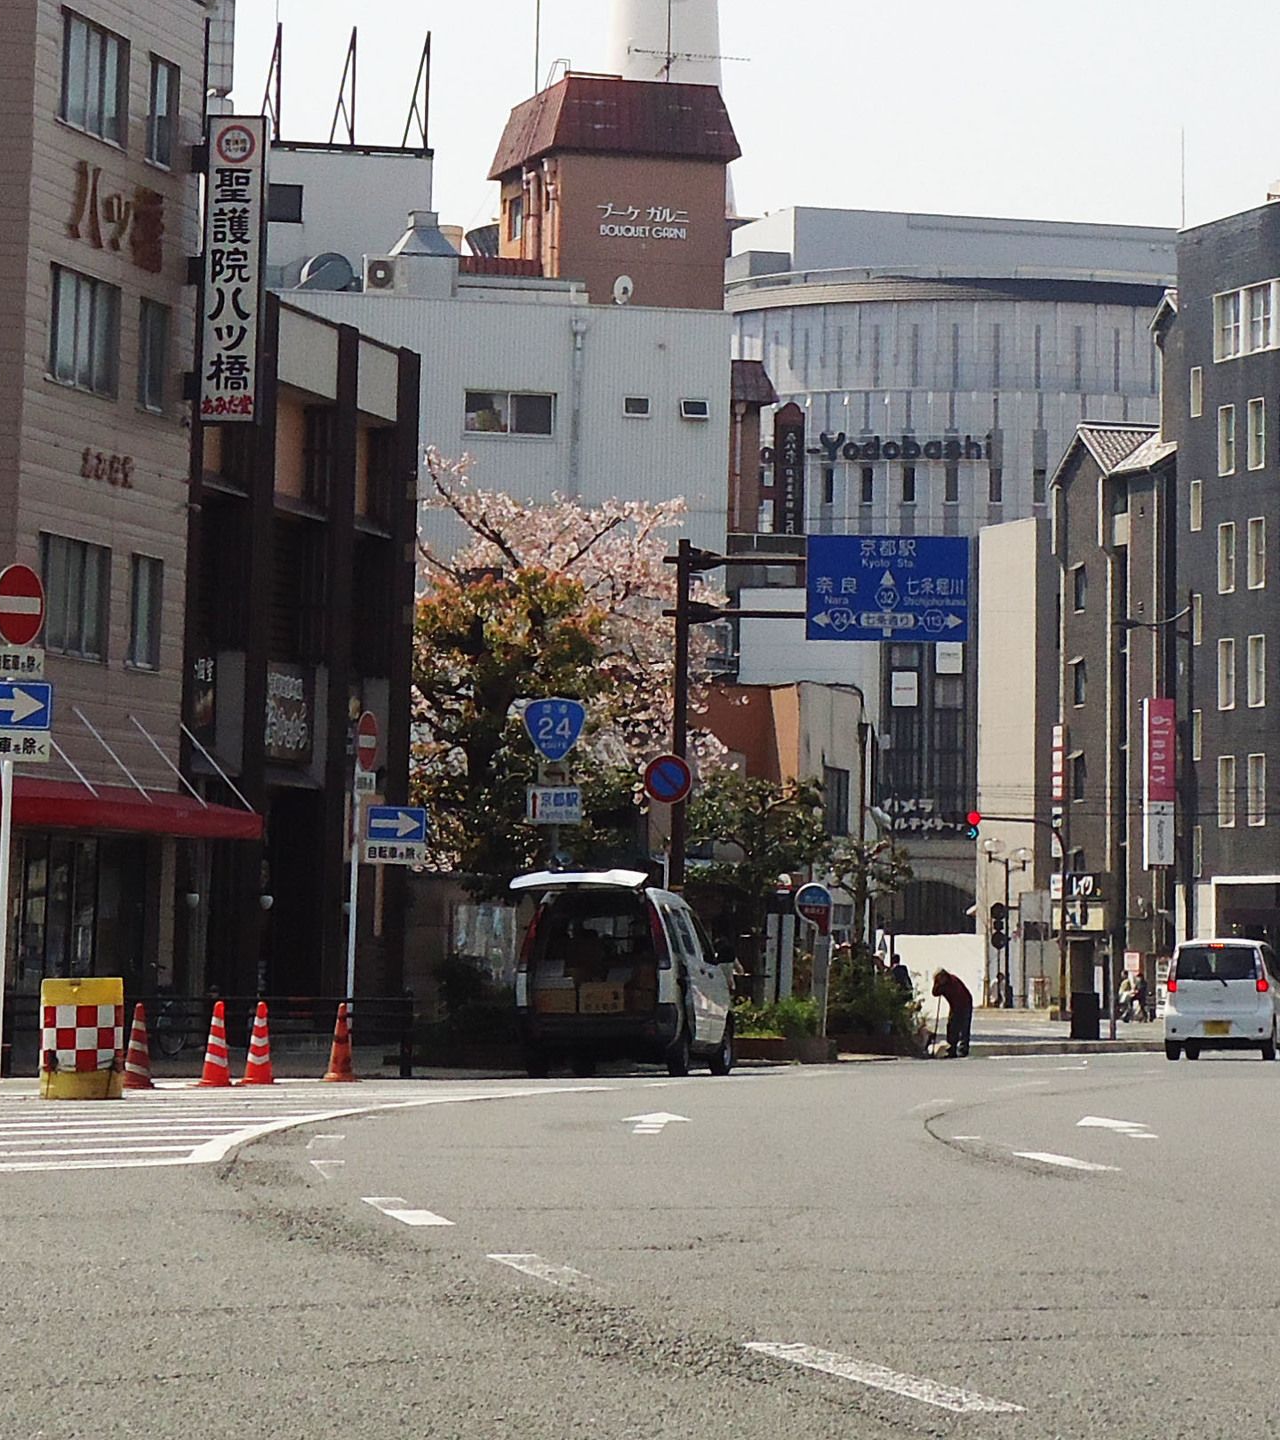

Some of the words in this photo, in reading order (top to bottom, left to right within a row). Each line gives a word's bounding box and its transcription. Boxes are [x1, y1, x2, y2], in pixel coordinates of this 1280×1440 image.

[645, 206, 690, 223] ガルニ
[600, 223, 650, 238] BOUQUET
[651, 226, 687, 240] GARNI
[206, 166, 253, 392] 聖護院八ツ橋
[201, 394, 253, 417] あみだ堂
[859, 539, 917, 558] 京都駅
[861, 558, 890, 569] Kyoto
[816, 576, 858, 594] 奈良
[906, 577, 965, 596] 七条堀川
[824, 595, 849, 606] Nara
[880, 591, 895, 605] 32
[833, 615, 848, 626] 24
[926, 615, 942, 627] 113
[538, 717, 572, 740] 24
